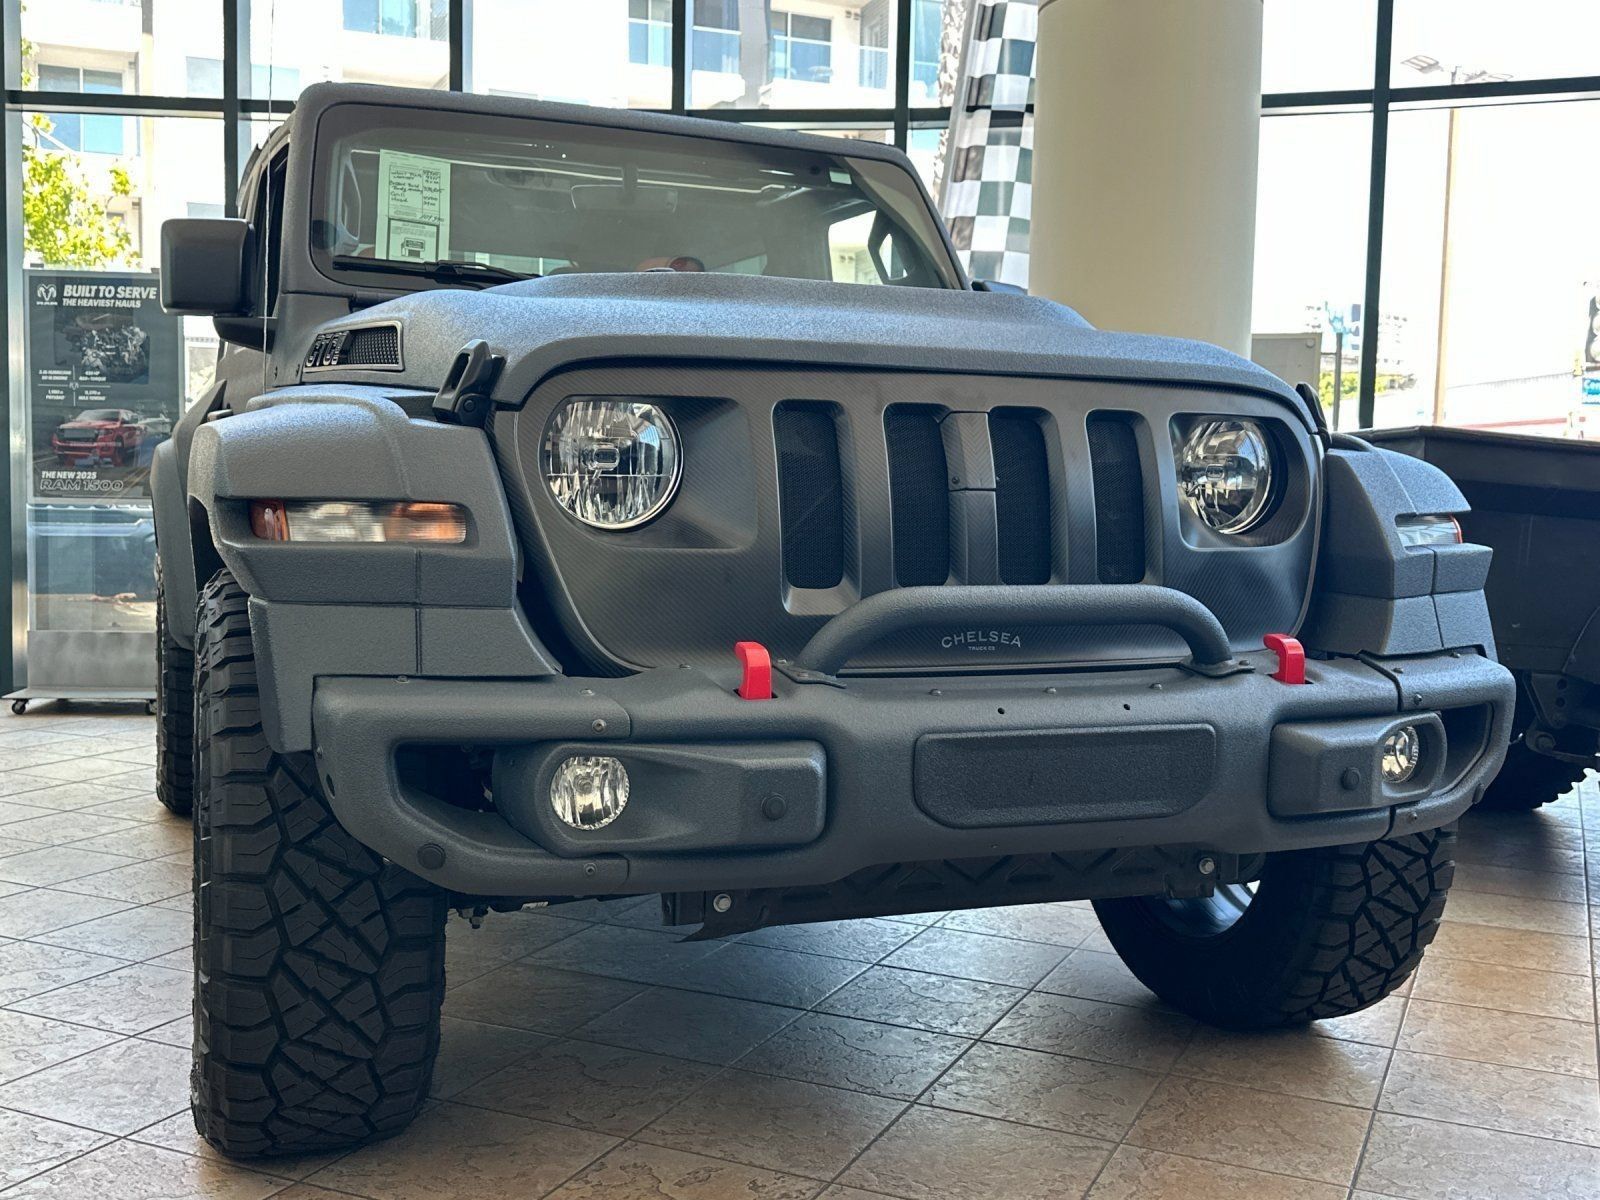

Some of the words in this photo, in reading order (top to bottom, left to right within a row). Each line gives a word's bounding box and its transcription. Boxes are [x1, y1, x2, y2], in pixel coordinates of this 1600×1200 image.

[63, 285, 97, 298] BUILT
[98, 286, 116, 299] TO
[116, 286, 158, 299] SERVE
[62, 298, 77, 307] THE
[77, 298, 115, 308] HEAVIEST
[115, 299, 142, 309] HAULS
[41, 470, 56, 479] THE
[56, 471, 76, 479] NEW
[75, 471, 98, 480] 2025
[40, 479, 81, 491] RAM
[82, 479, 124, 492] 1500
[941, 630, 1021, 648] CHELSEA
